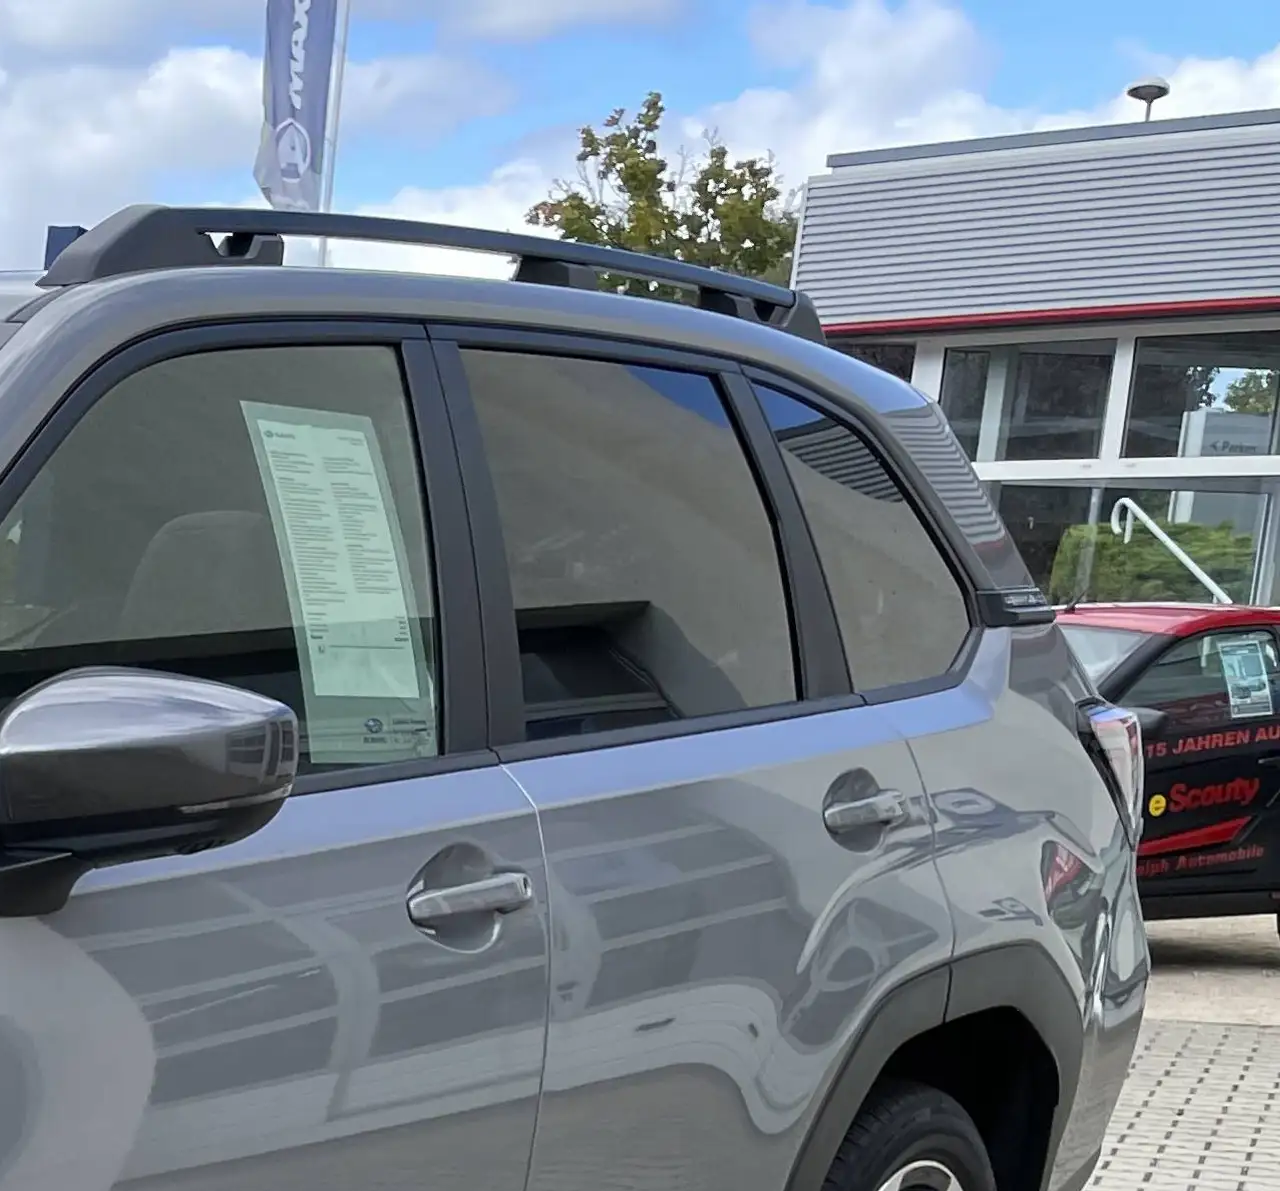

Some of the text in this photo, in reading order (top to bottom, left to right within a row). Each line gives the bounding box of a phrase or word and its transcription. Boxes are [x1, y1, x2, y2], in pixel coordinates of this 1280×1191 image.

[1146, 725, 1280, 758] 15 JAHREN AU
[1169, 778, 1259, 812] Scouty
